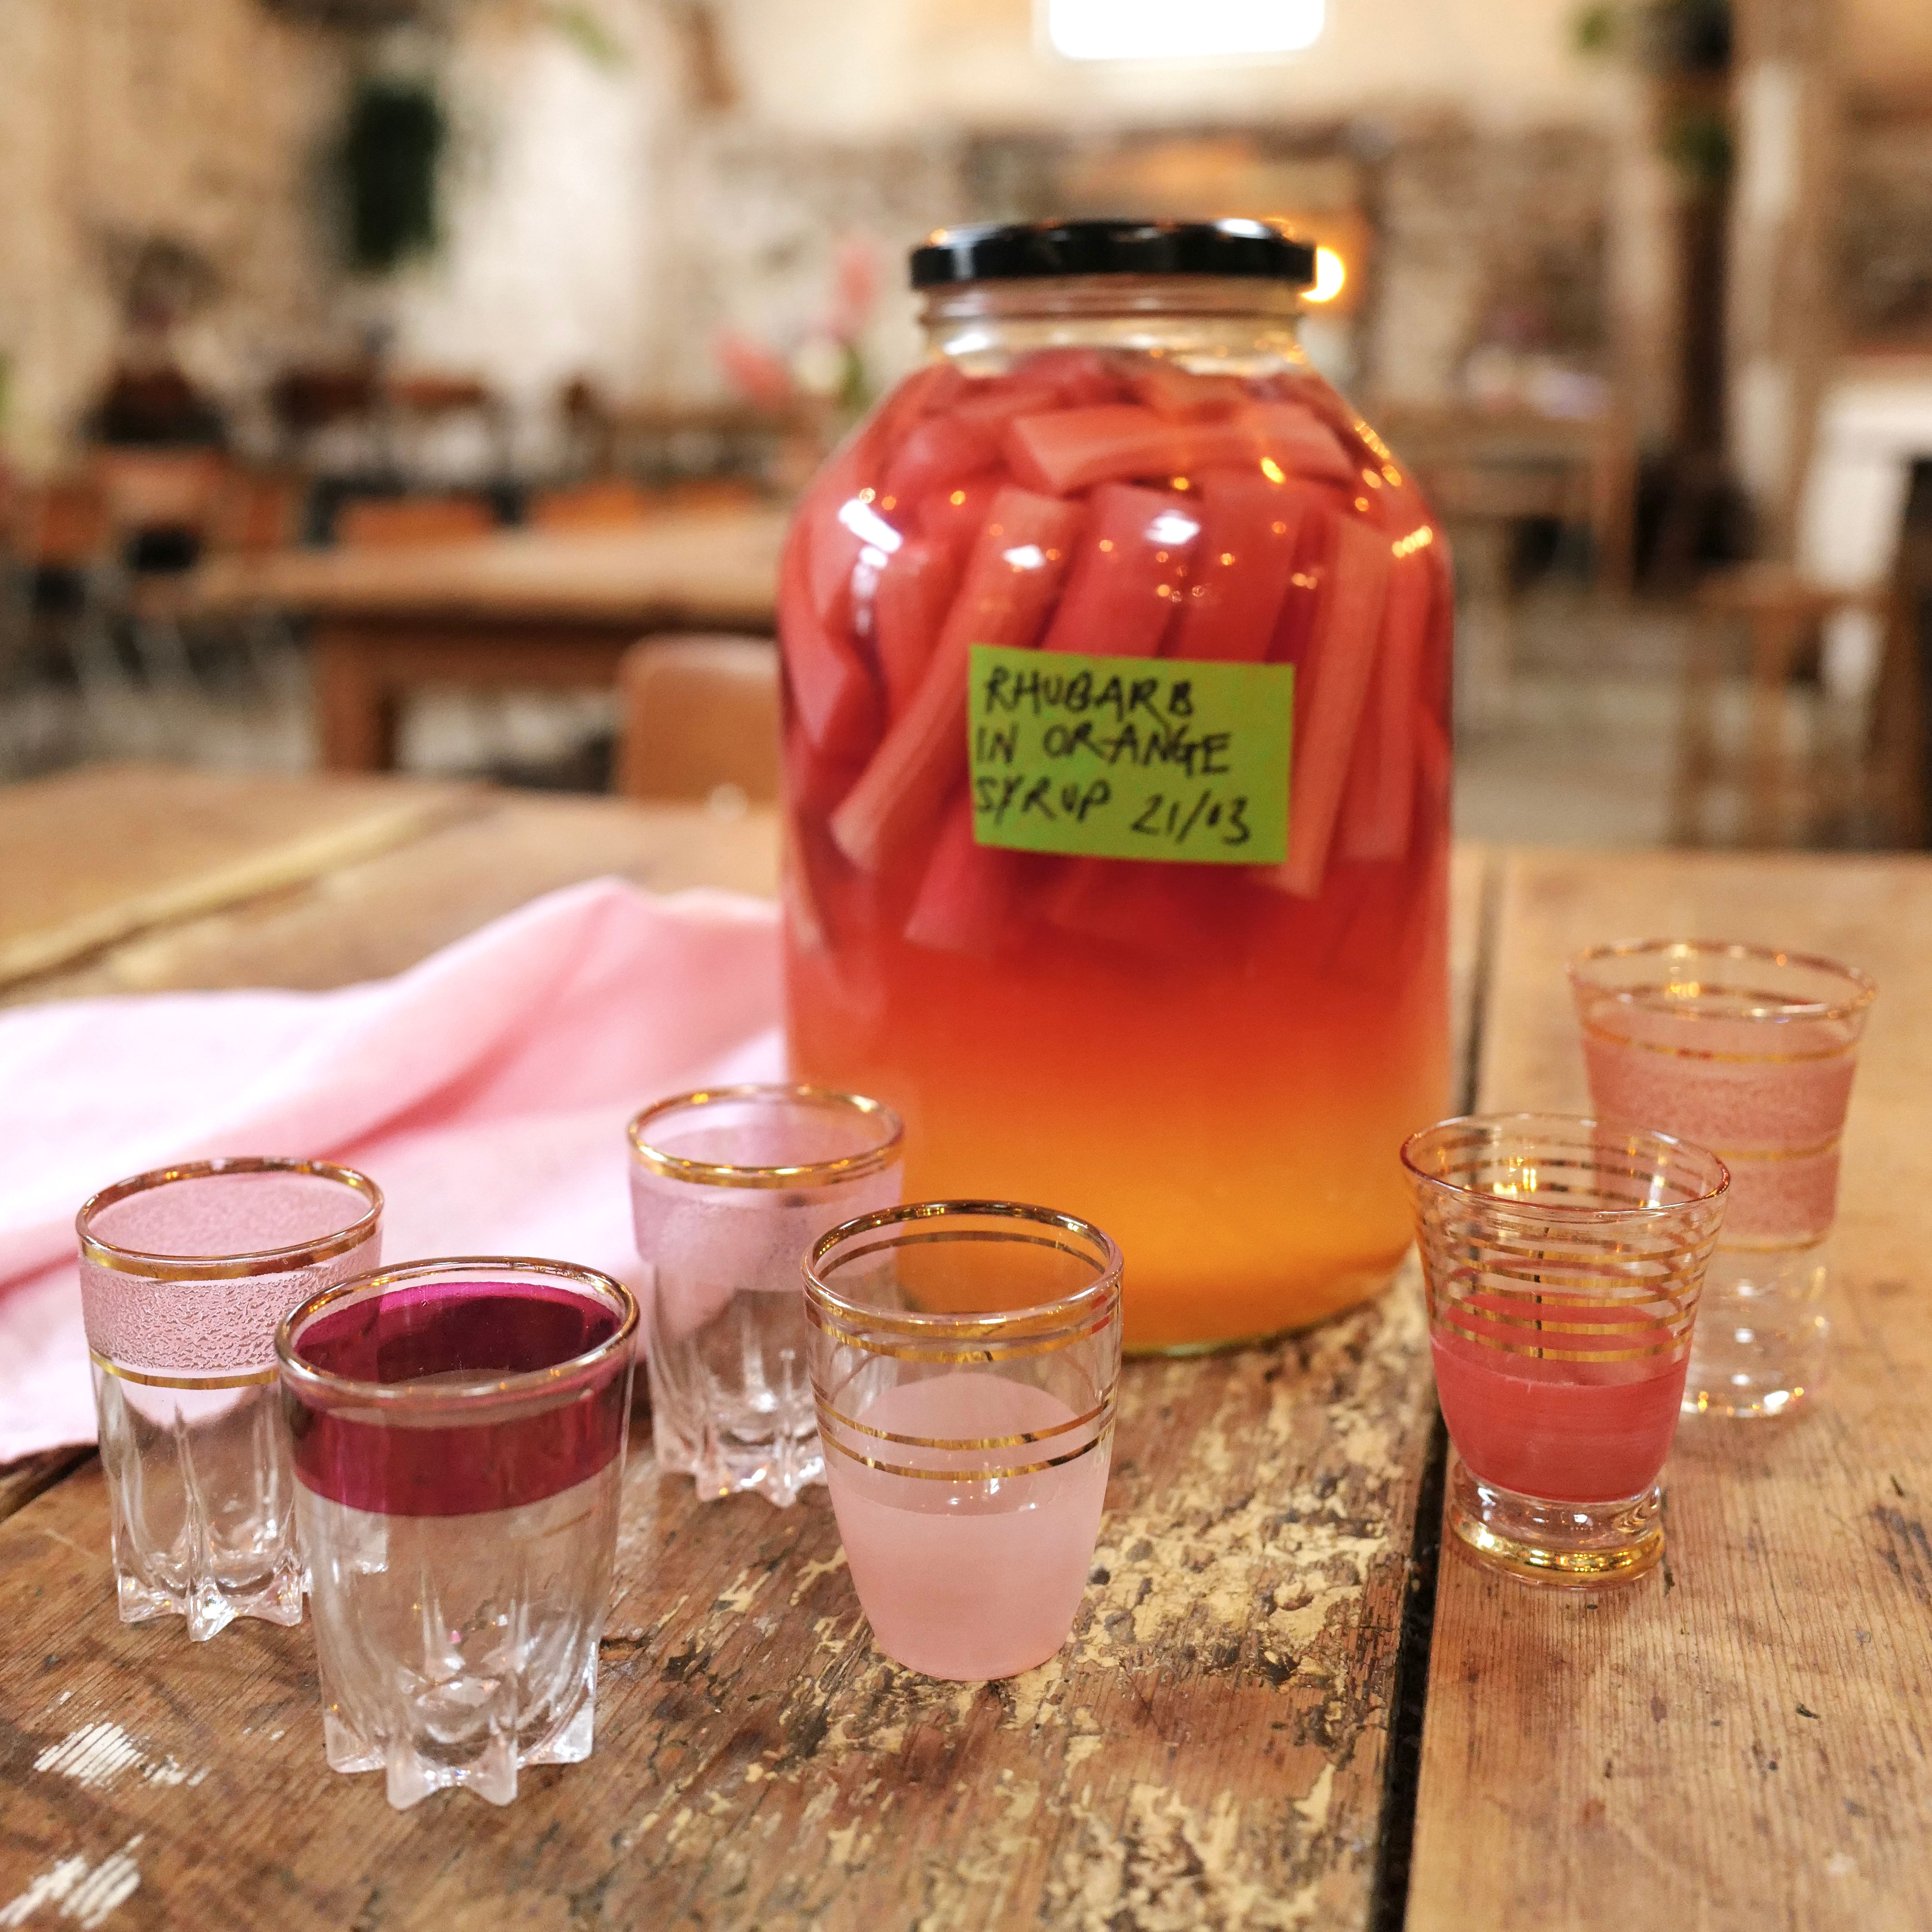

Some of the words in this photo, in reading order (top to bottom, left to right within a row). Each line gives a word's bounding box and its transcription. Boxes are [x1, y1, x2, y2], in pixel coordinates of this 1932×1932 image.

[985, 665, 1194, 730] RHUBARB
[976, 723, 1019, 764] IN
[1042, 721, 1233, 778] ORANGE
[975, 773, 1112, 825] SYRUP
[1130, 790, 1251, 845] 21/03
